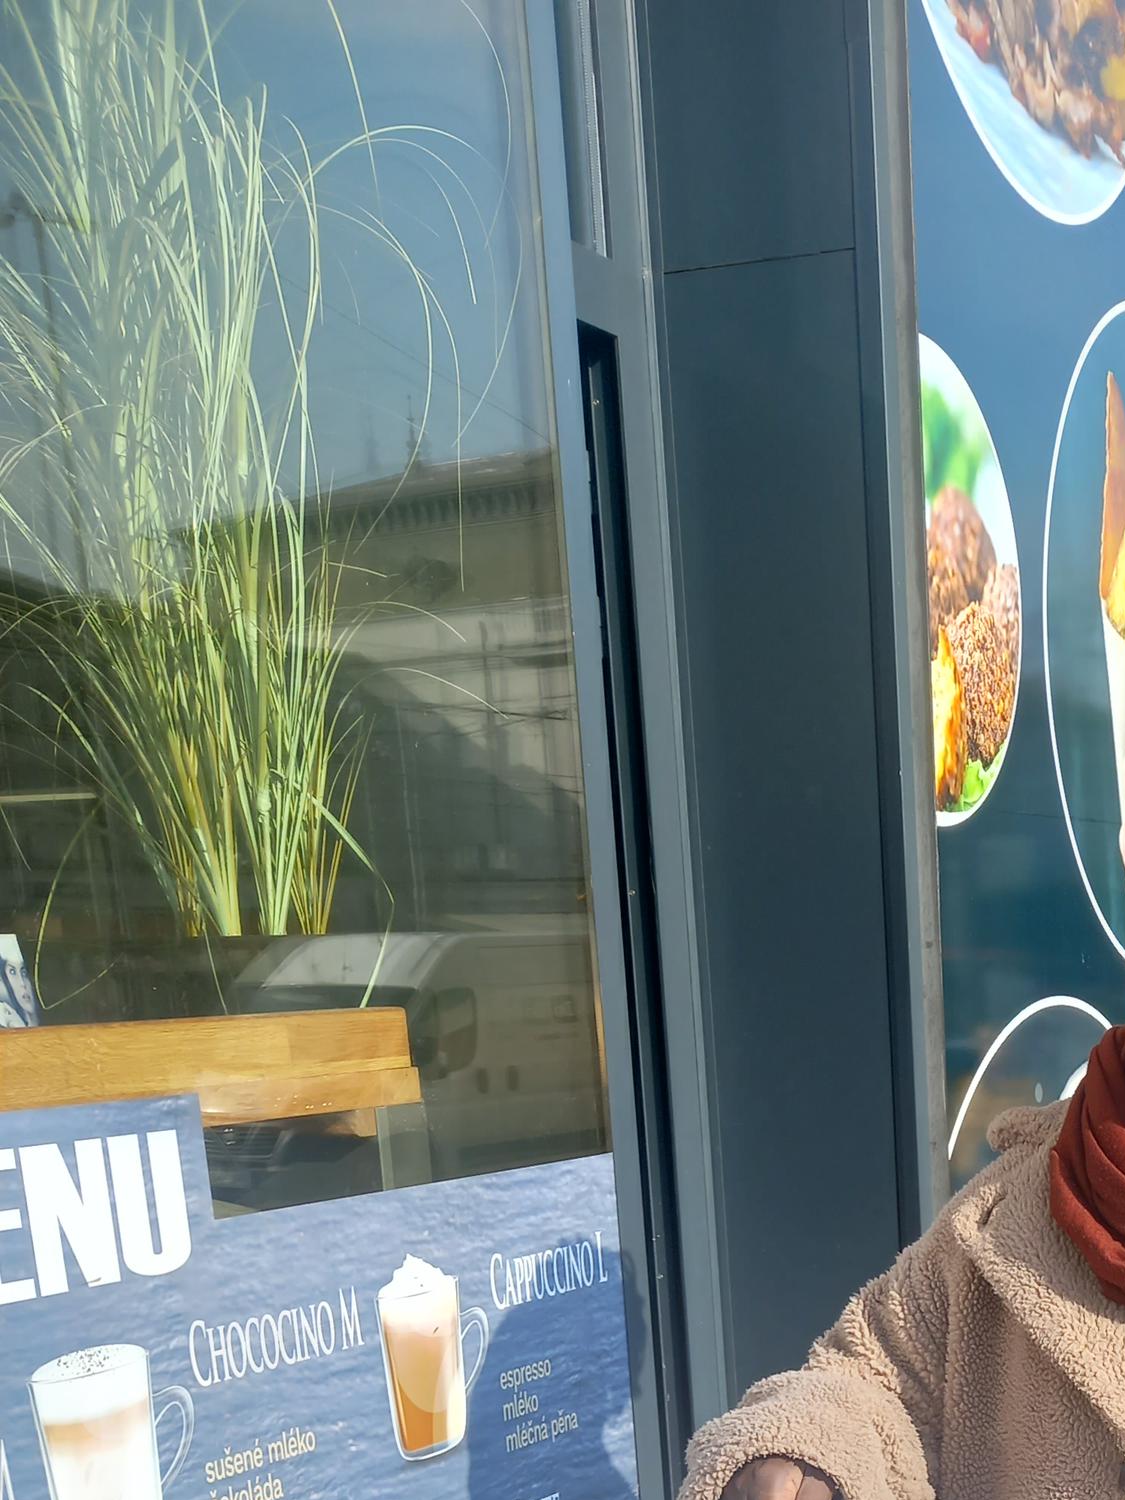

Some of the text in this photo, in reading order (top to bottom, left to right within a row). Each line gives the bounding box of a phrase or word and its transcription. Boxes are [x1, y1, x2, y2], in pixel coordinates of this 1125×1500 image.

[490, 1231, 608, 1309] CAPPUCCINO L
[189, 1286, 365, 1387] CHOCOCINO M
[500, 1359, 552, 1392] espresso
[503, 1391, 538, 1422] mléko
[506, 1408, 579, 1453] mléčná pěna
[205, 1427, 316, 1483] sušené mléko
